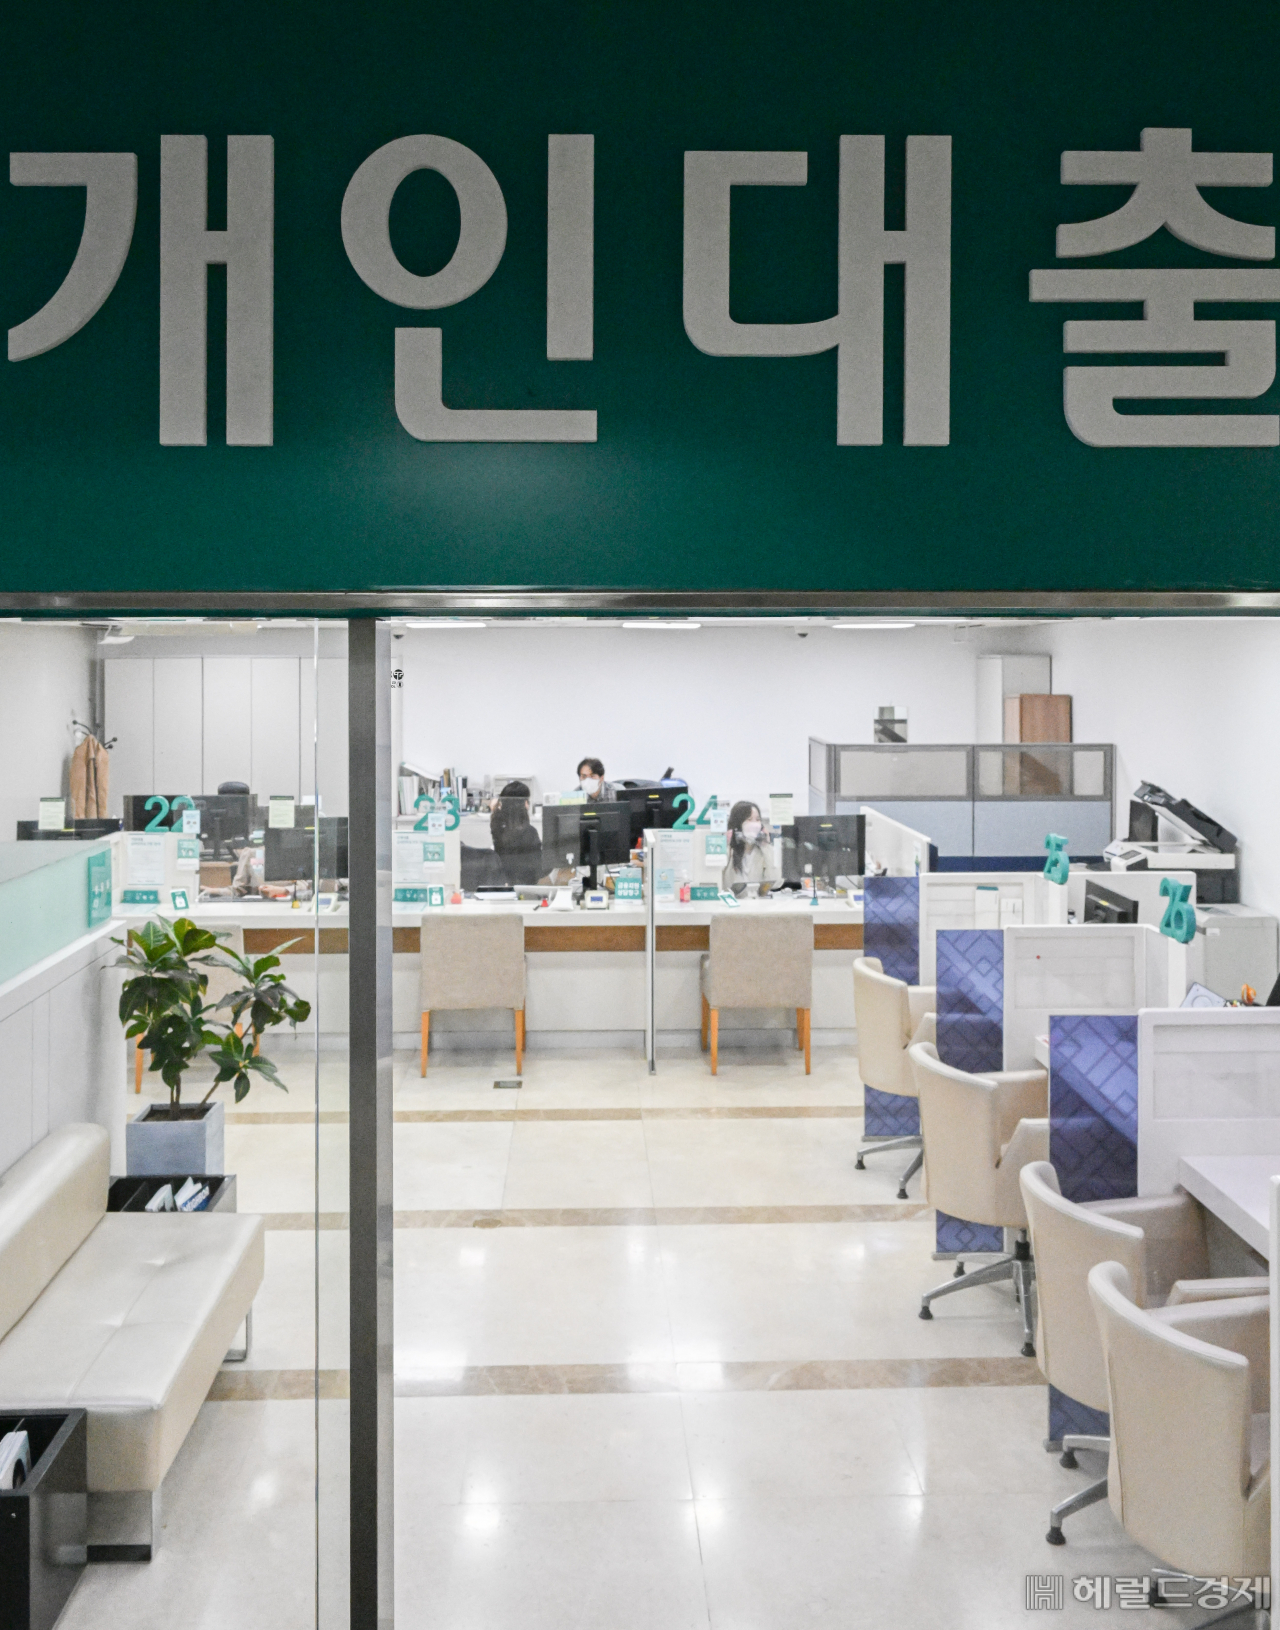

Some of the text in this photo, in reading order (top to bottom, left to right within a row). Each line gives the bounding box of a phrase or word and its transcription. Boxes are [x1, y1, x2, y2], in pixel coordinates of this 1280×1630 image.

[8, 127, 1280, 447] 개인대출
[144, 795, 196, 833] 22
[413, 793, 461, 831] 23
[672, 793, 718, 830] 24
[1043, 832, 1070, 885] 25
[1159, 877, 1197, 944] 26
